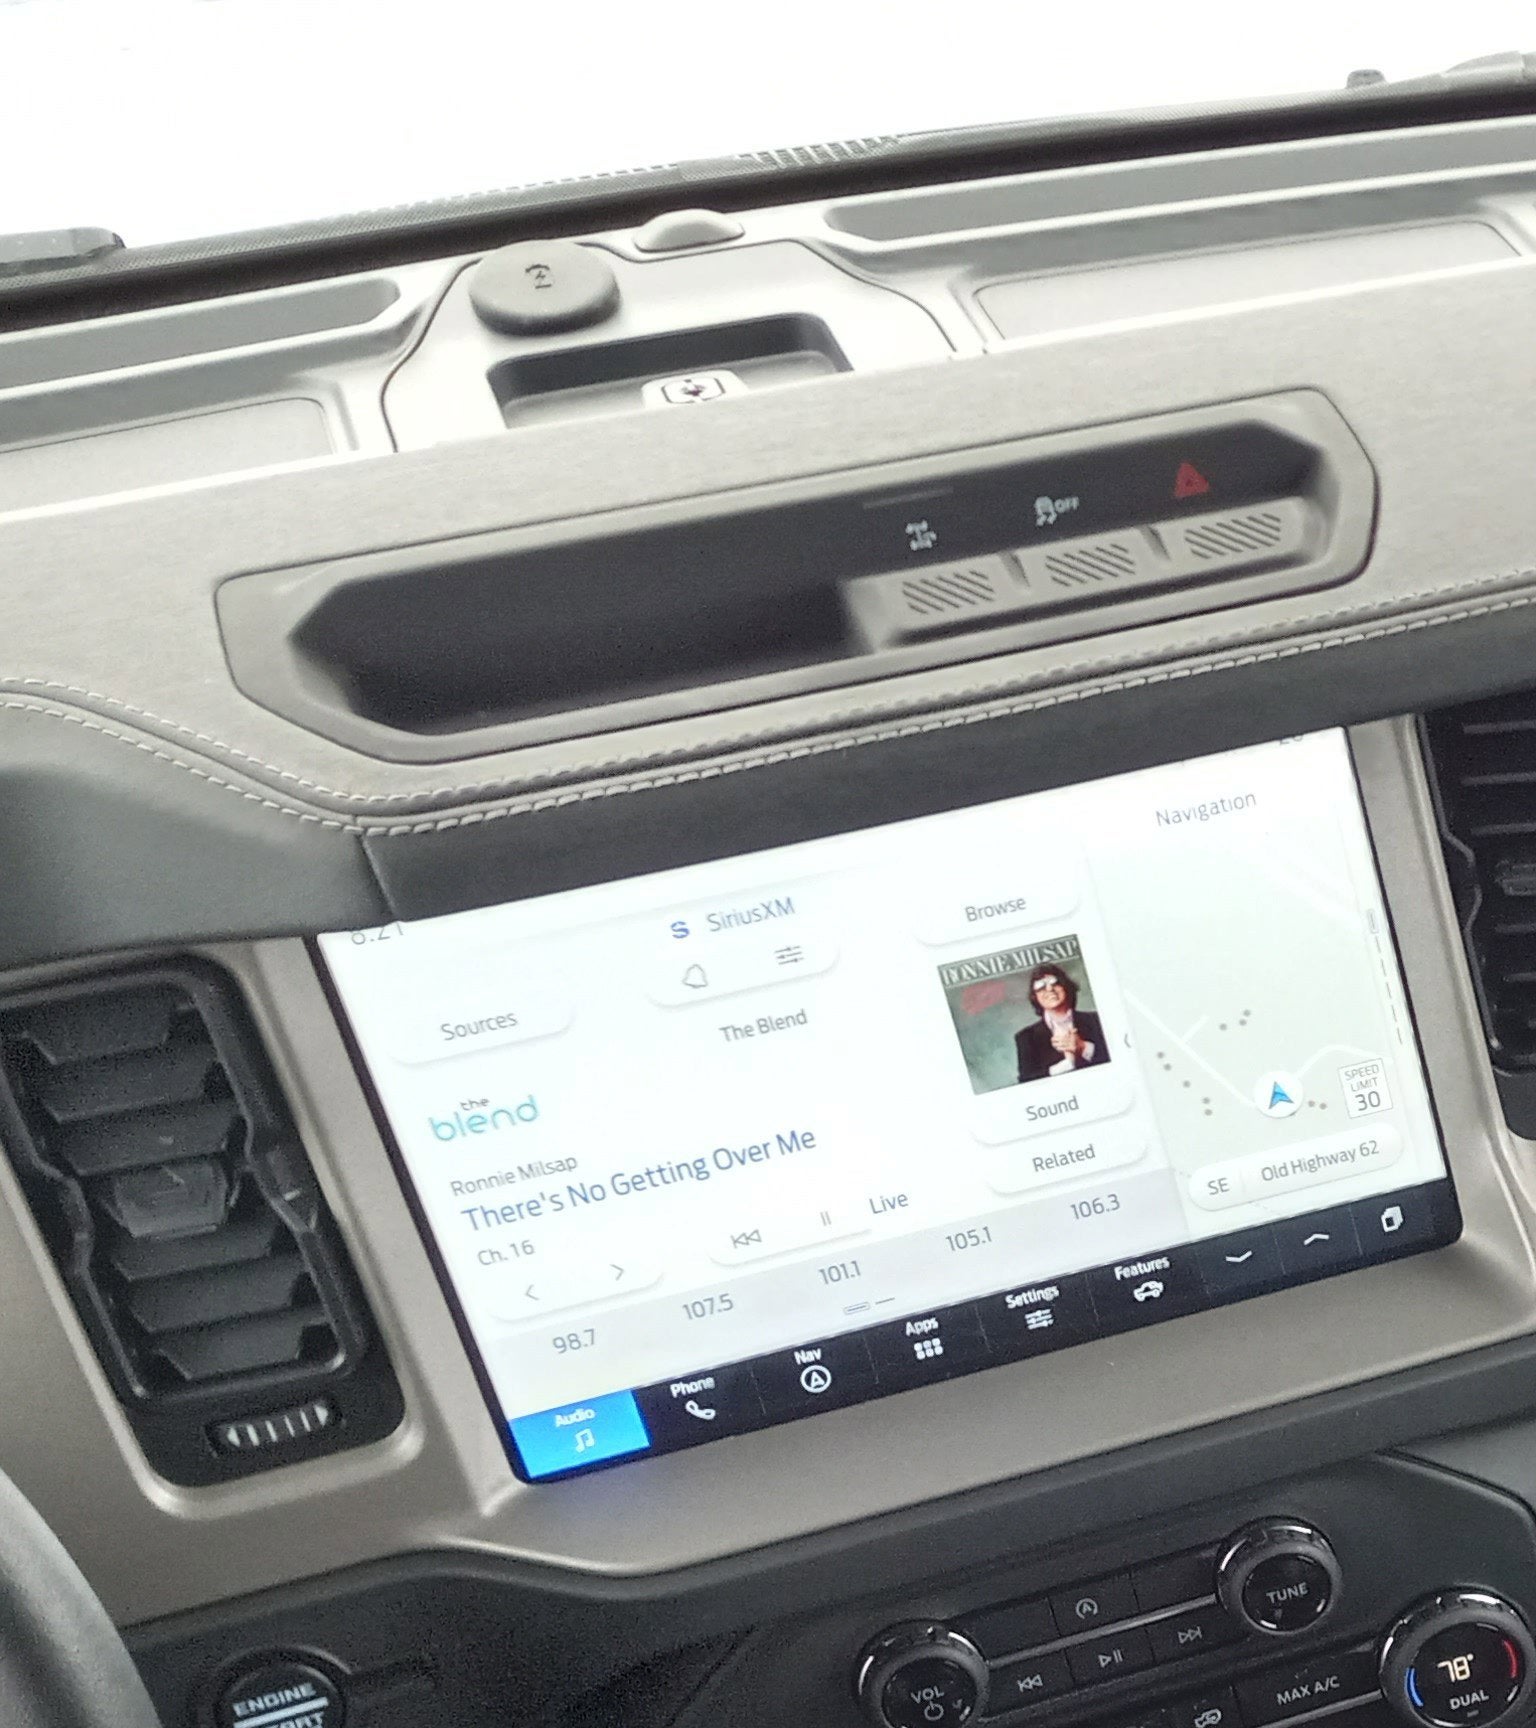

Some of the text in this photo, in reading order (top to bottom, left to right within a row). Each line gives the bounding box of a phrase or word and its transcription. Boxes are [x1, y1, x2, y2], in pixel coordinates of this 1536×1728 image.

[1054, 495, 1080, 514] OFF
[1156, 792, 1258, 827] Navigation
[706, 897, 796, 932] SiriusXM
[965, 897, 1027, 923] Browse
[440, 1012, 519, 1041] Sources
[718, 1008, 809, 1043] The Blend
[1344, 1063, 1380, 1081] SPEED
[1350, 1076, 1379, 1093] LIMIT
[459, 1096, 490, 1112] the
[1025, 1094, 1080, 1122] Sound
[1354, 1090, 1382, 1112] 30
[428, 1094, 540, 1142] blend
[1032, 1143, 1097, 1173] Related
[1260, 1139, 1380, 1182] Old Highway 62
[449, 1154, 580, 1197] Ronnie Milsap
[460, 1128, 818, 1232] There's No Getting Over Me
[1207, 1176, 1231, 1196] SE
[868, 1192, 910, 1215] Live
[1070, 1193, 1121, 1221] 106.3
[945, 1226, 993, 1252] 105.1
[477, 1239, 536, 1267] Ch. 16
[818, 1260, 862, 1285] 101.1
[1113, 1255, 1171, 1281] Features
[681, 1293, 735, 1321] 107.5
[1004, 1284, 1060, 1310] Settings
[905, 1316, 940, 1338] Apps
[551, 1327, 598, 1355] 98.7
[794, 1347, 823, 1366] Nav
[669, 1374, 716, 1399] Phone
[554, 1406, 596, 1429] Audio
[1266, 1581, 1308, 1605] TUNE
[1437, 1652, 1475, 1683] 78°
[232, 1681, 317, 1717] ENGINE
[911, 1685, 945, 1704] VOL
[1276, 1673, 1341, 1707] MAX A/C
[1449, 1688, 1491, 1711] DUAL
